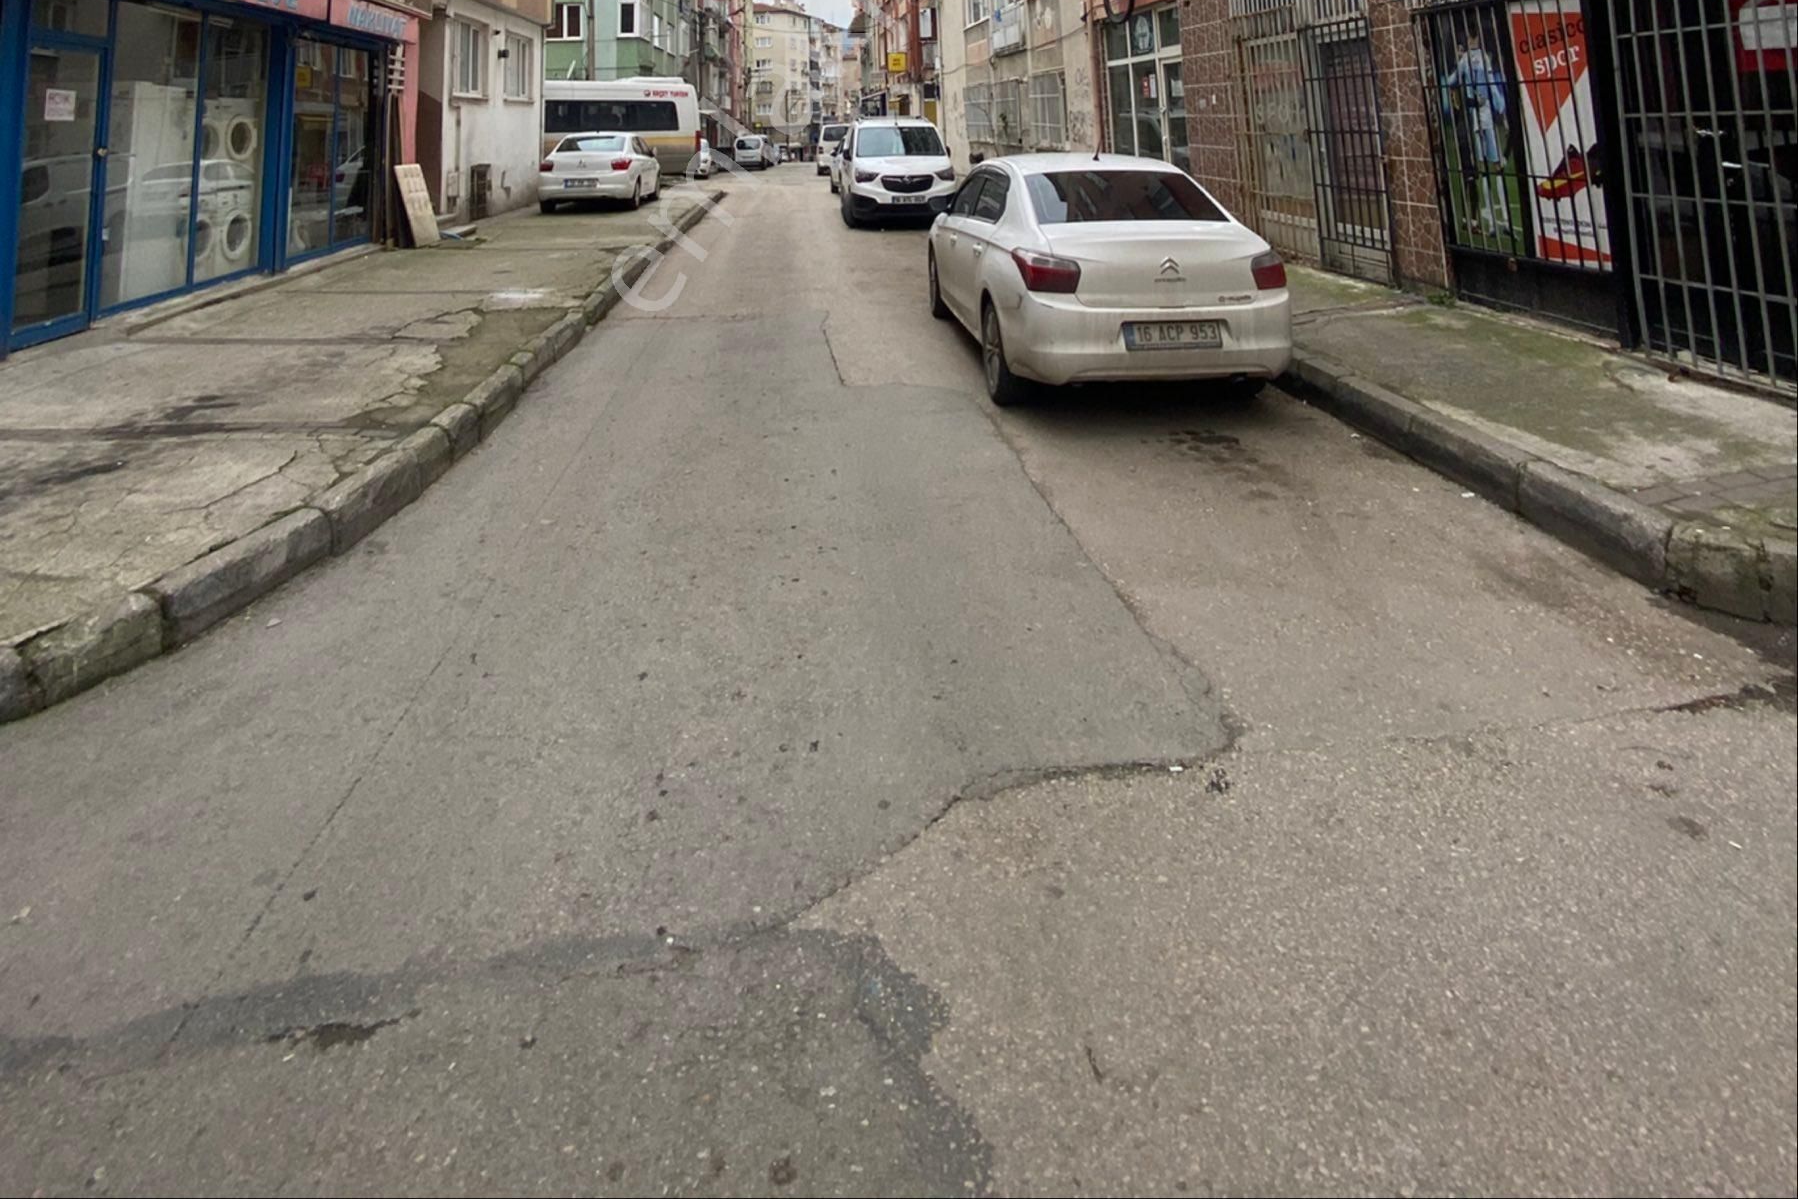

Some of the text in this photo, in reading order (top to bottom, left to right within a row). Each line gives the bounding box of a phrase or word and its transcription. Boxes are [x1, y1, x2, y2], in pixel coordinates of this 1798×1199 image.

[1533, 45, 1580, 78] spor
[1137, 323, 1218, 343] 16 ACP 953
